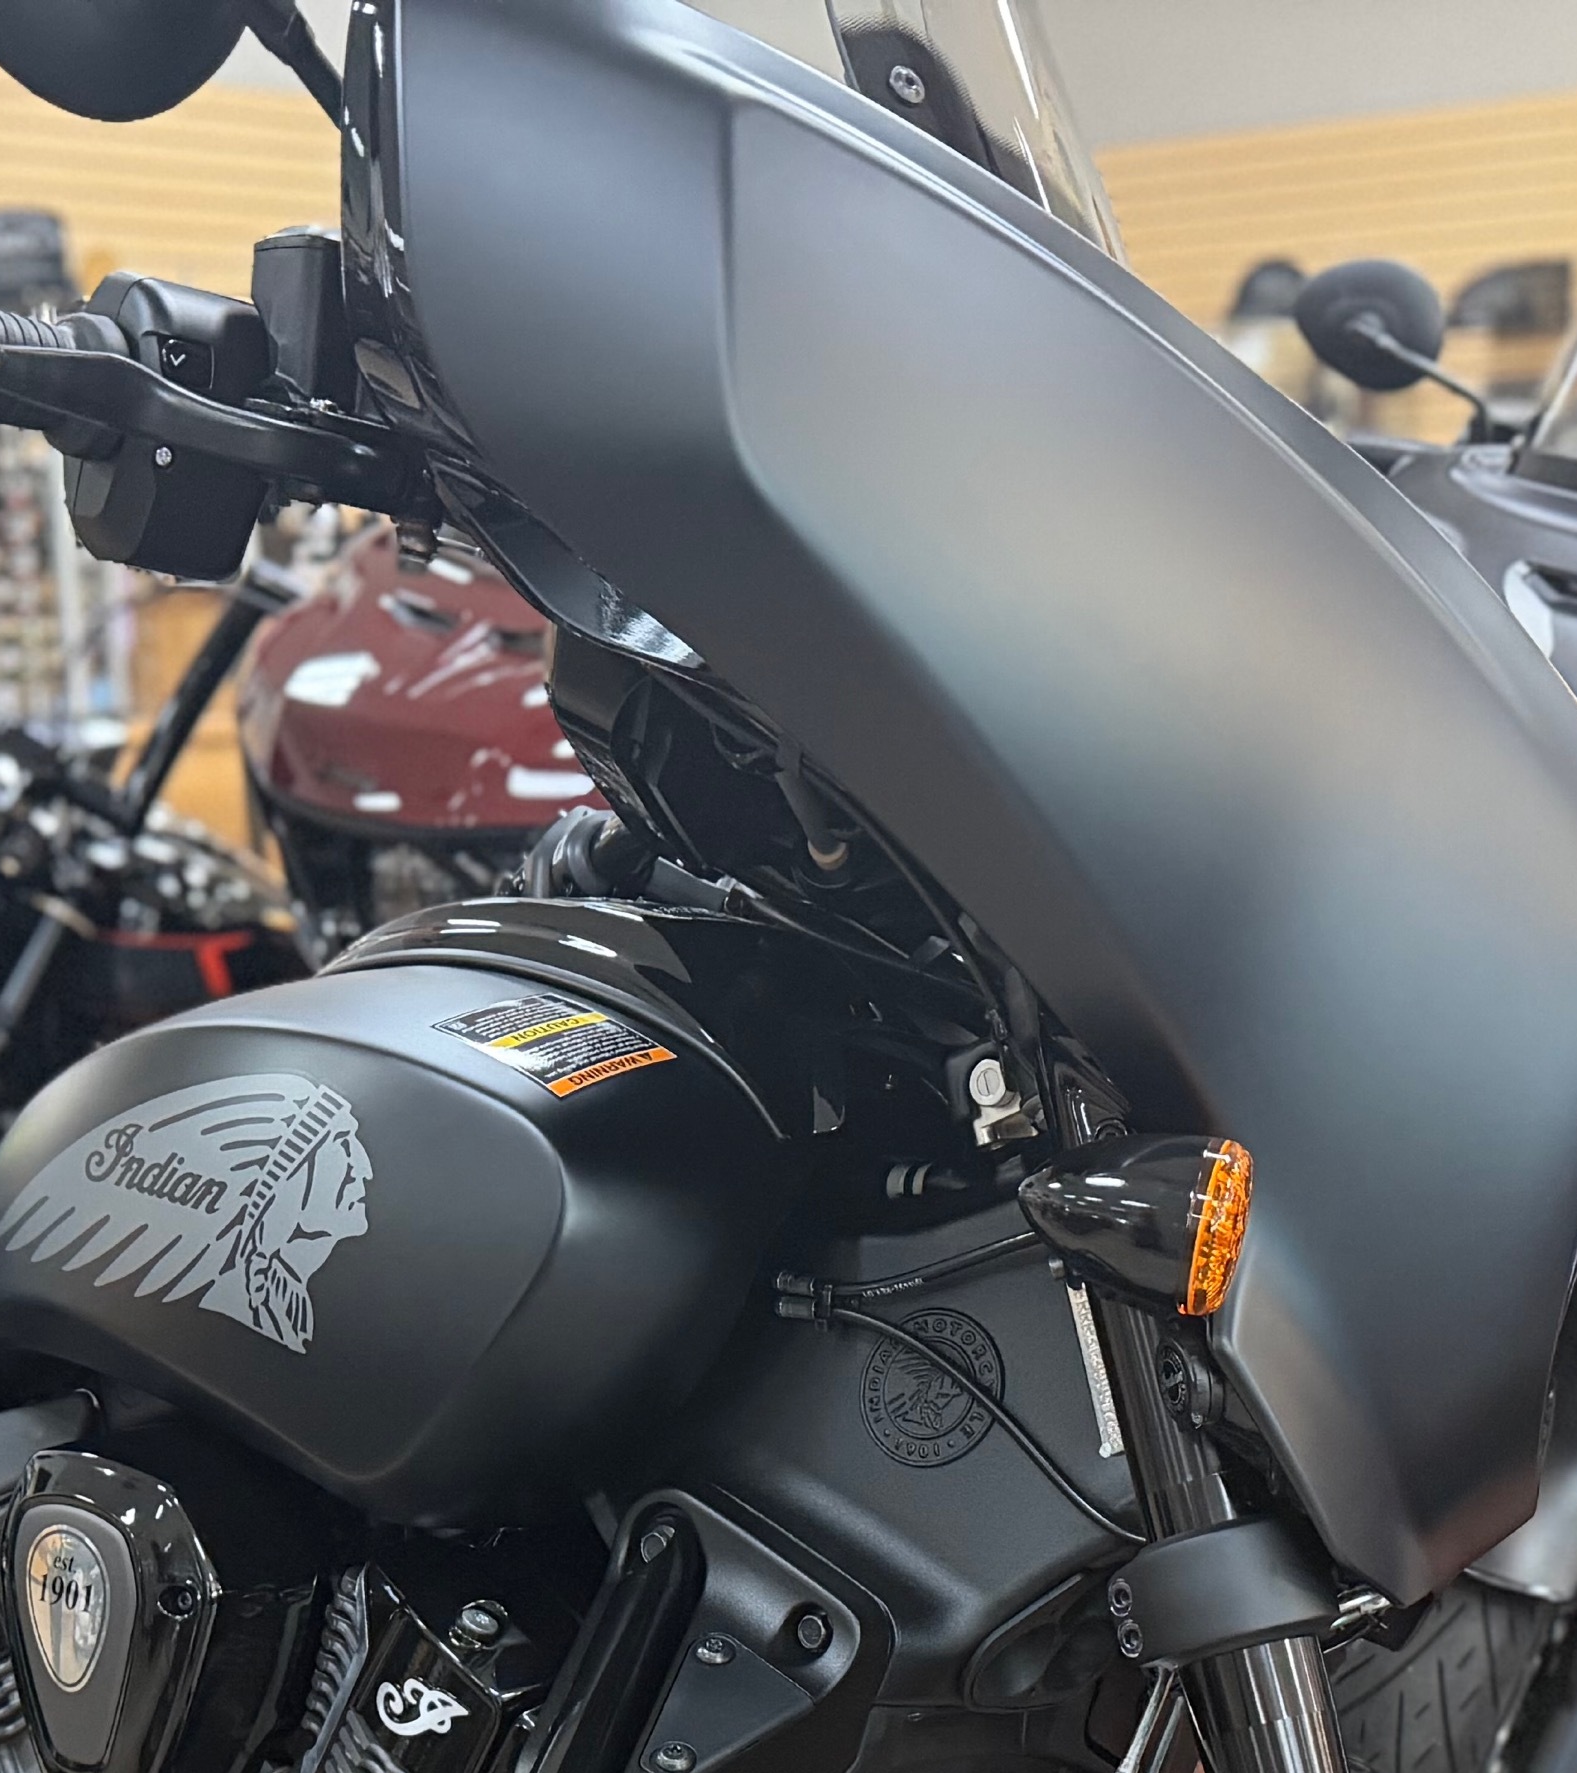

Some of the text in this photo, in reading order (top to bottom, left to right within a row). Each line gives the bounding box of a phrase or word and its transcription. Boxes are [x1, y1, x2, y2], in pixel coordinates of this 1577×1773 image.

[510, 1018, 580, 1042] CAUTION
[568, 1055, 641, 1086] WARNING
[84, 1122, 229, 1215] Indian
[893, 1437, 941, 1459] 1901
[53, 1556, 76, 1573] est.
[39, 1574, 92, 1613] 1901
